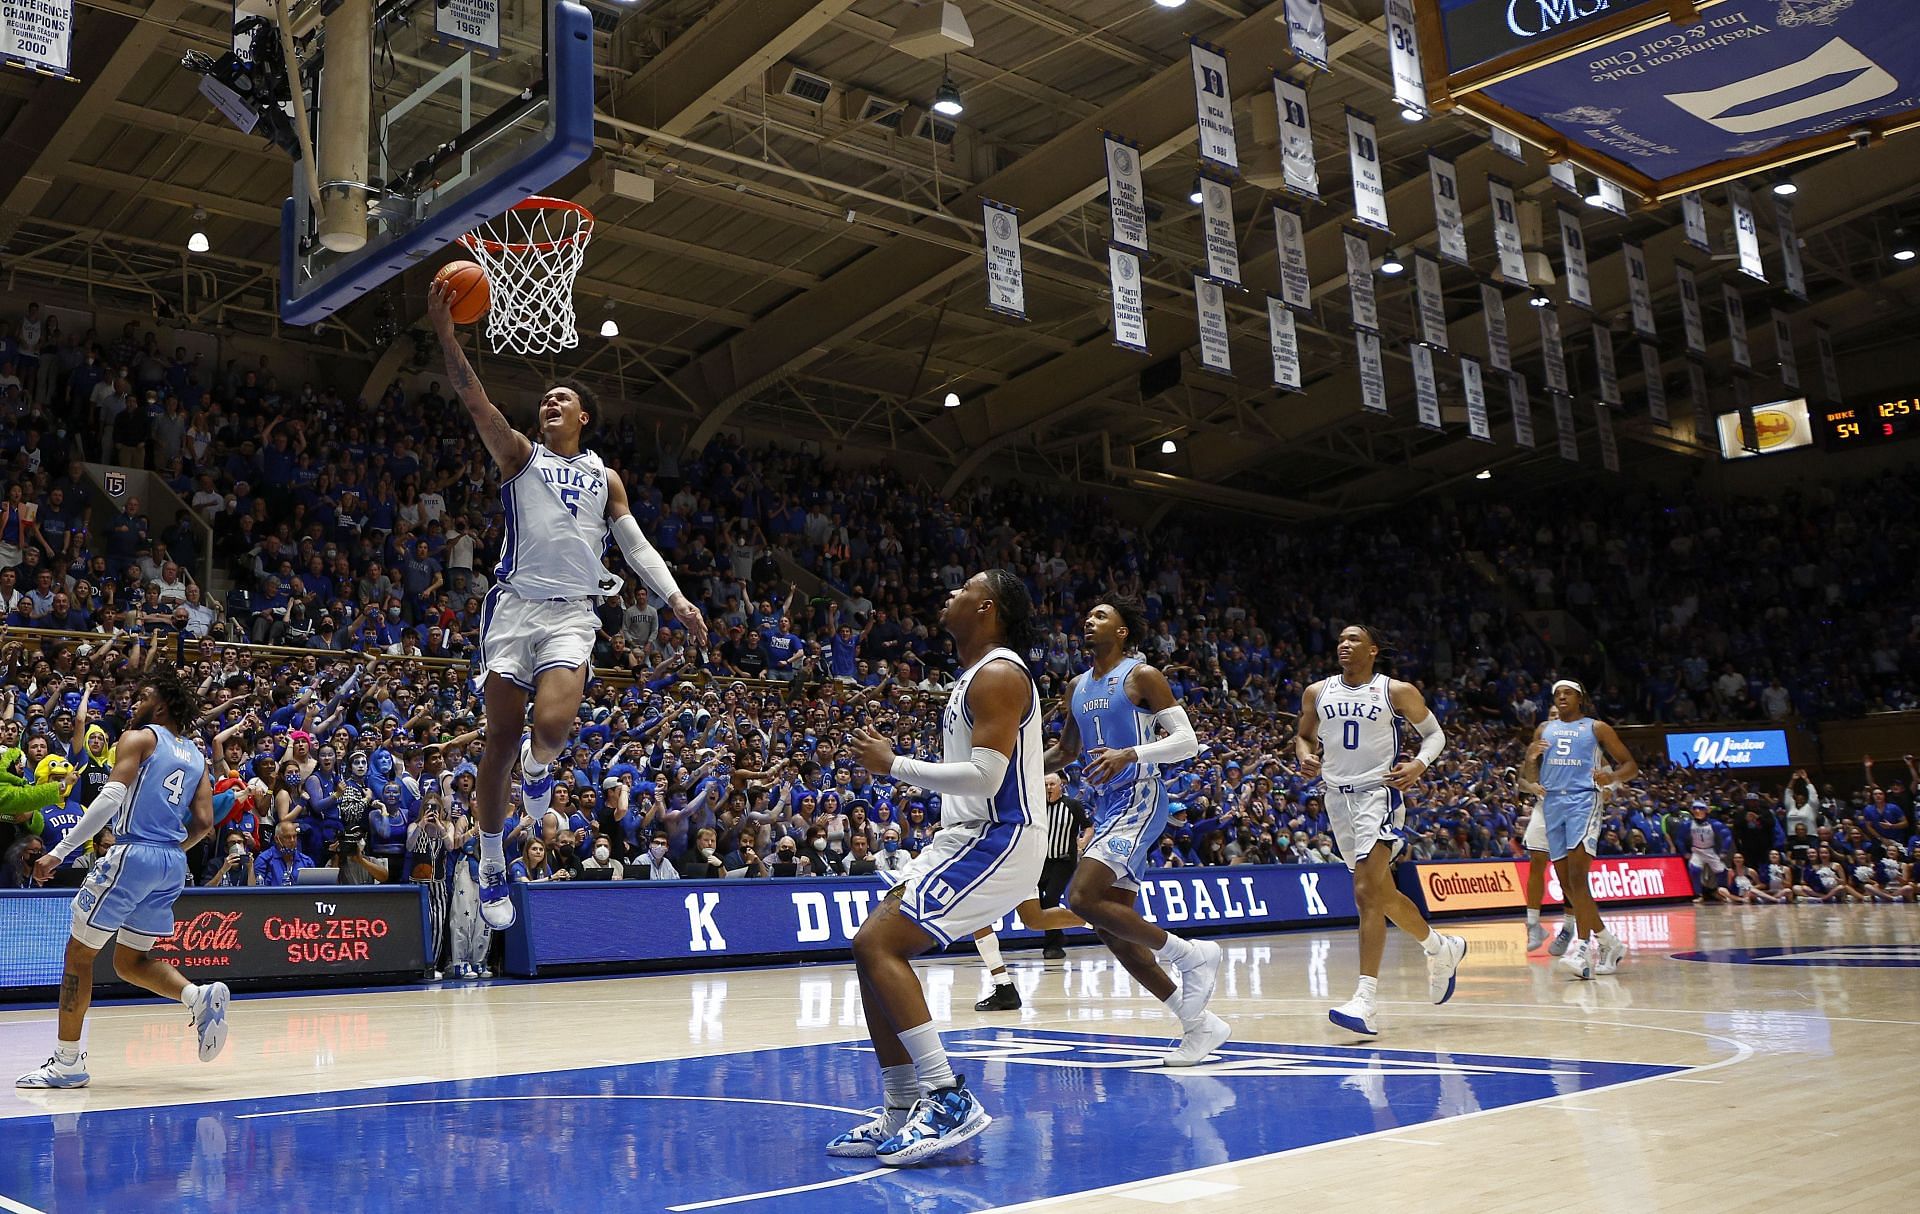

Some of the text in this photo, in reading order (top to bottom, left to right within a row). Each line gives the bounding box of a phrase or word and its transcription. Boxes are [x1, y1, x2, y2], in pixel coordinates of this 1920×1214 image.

[1, 0, 69, 19] NFERENCE
[449, 4, 491, 19] EGULAR SEASON
[452, 0, 495, 12] MPIONS
[3, 7, 65, 31] CHAMPIONS
[451, 10, 486, 25] TOURNAMENT
[6, 20, 59, 39] REGULAR SEASON
[12, 29, 53, 45] TOURNAMENT
[456, 20, 481, 36] 1963
[17, 39, 47, 55] 2000
[1392, 23, 1415, 57] 32
[1589, 11, 1749, 72] Inn & Golf Club
[1591, 23, 1770, 83] Washington Duke
[1208, 106, 1224, 119] NCAA
[1201, 117, 1219, 131] FINAL
[1826, 410, 1855, 421] DUKE
[1837, 423, 1860, 439] 54
[1883, 424, 1894, 436] 3
[109, 478, 123, 492] 15
[541, 467, 603, 497] DUKE
[561, 488, 580, 519] 5
[1083, 698, 1109, 714] NORTH
[1323, 702, 1382, 722] DUKE
[1093, 716, 1105, 746] 1
[1343, 720, 1359, 750] 0
[1553, 729, 1579, 738] NORTH
[1556, 739, 1572, 756] 5
[1693, 737, 1765, 764] Window
[88, 773, 109, 784] DUK
[162, 768, 186, 806] 4
[1429, 871, 1501, 902] Continental
[1588, 862, 1665, 898] ateFarm
[315, 901, 337, 916] Try
[684, 892, 727, 952] K
[792, 890, 890, 943] DU
[1300, 872, 1328, 916] K
[263, 916, 389, 941] Coke ZERO
[184, 955, 231, 968] SUGAR
[287, 941, 370, 964] SUGAR
